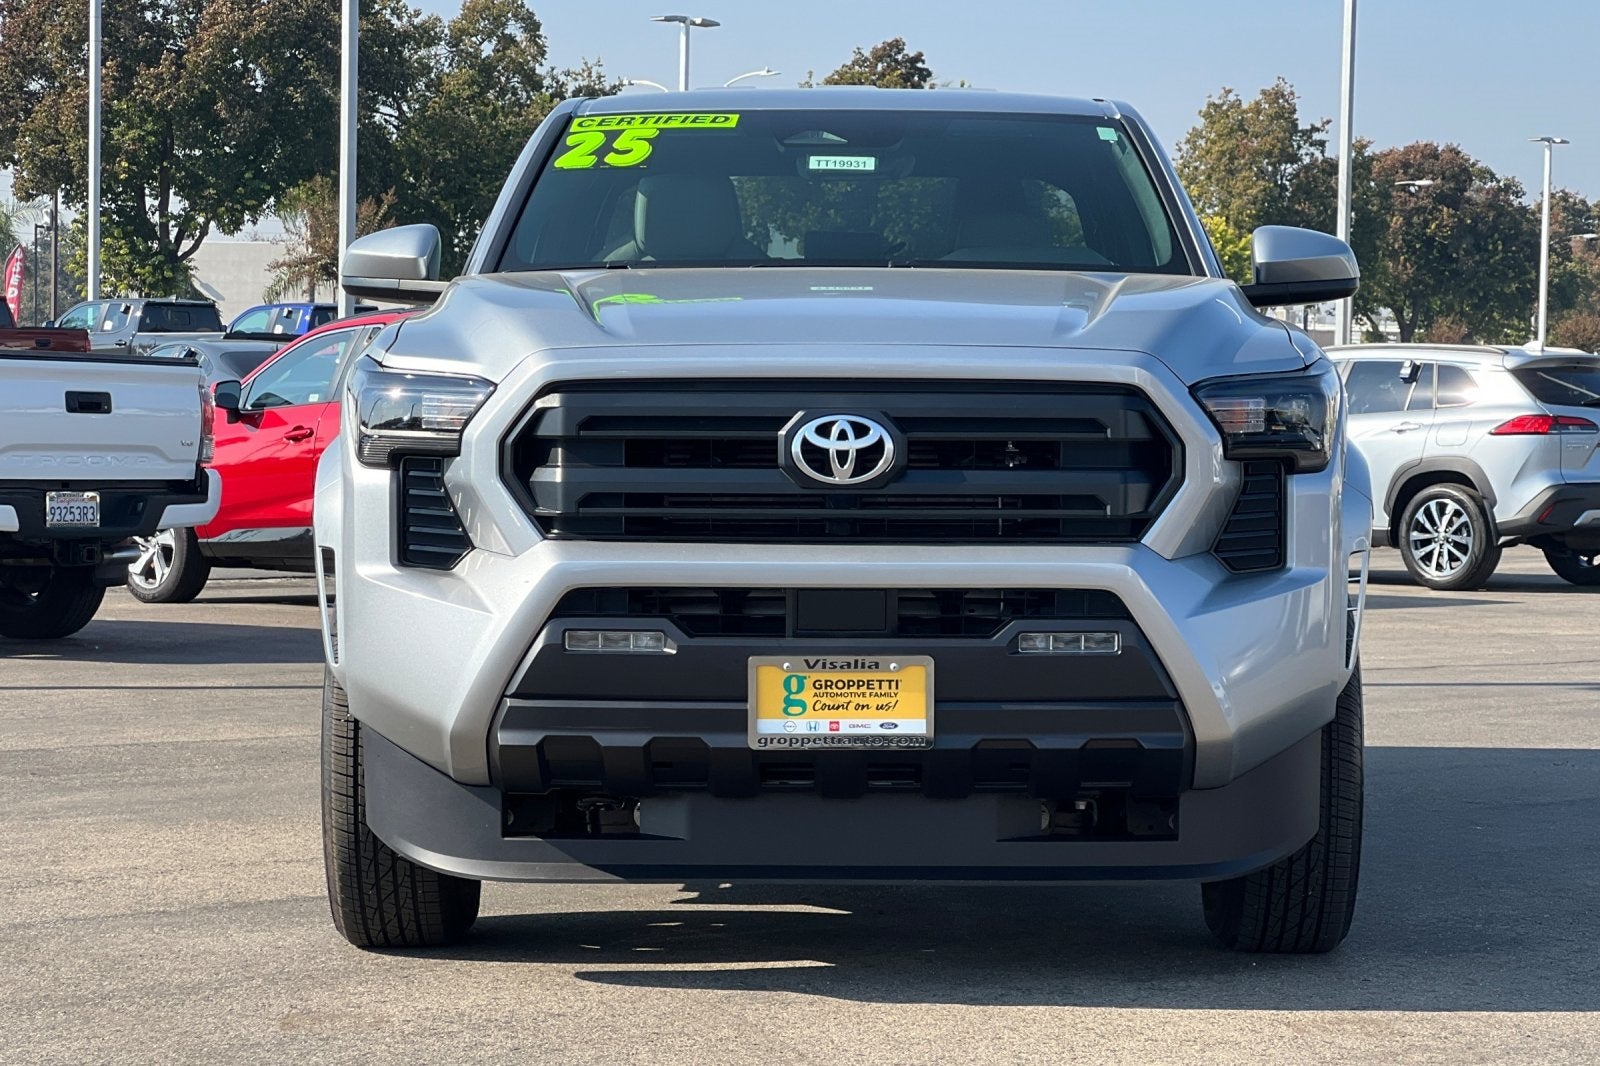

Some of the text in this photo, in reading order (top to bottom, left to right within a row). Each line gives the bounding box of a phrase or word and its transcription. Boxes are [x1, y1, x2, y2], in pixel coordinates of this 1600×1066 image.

[577, 114, 732, 128] CERTIFIED
[554, 128, 660, 169] 25
[815, 160, 867, 168] TT19931
[10, 454, 151, 466] TACOMA
[50, 505, 96, 522] 93253R3
[803, 658, 880, 670] Visalia
[812, 679, 900, 690] GROPPETTI
[812, 699, 899, 712] Count on us!
[757, 735, 927, 748] groppettiauto.com
